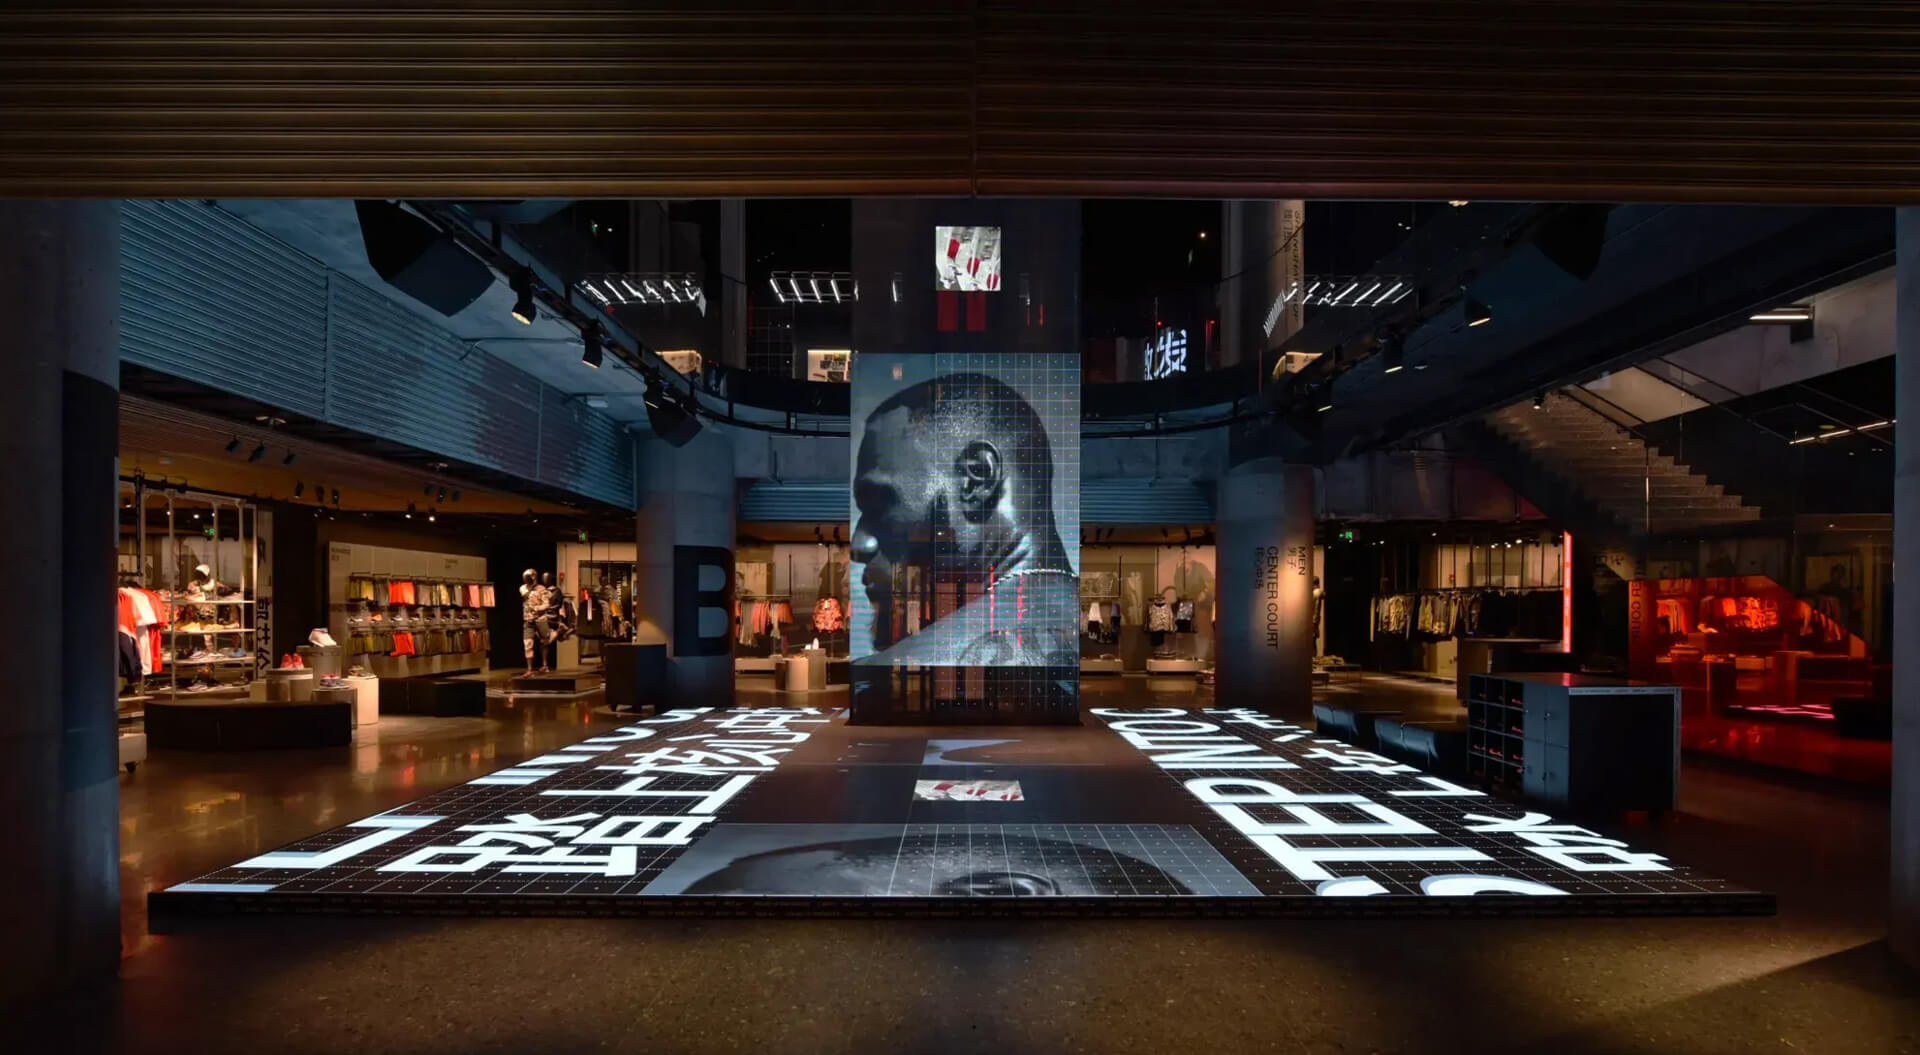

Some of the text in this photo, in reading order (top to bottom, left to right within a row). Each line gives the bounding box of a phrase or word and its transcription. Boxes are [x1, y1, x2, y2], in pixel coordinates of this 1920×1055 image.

[1266, 546, 1279, 649] CENTER COURT
[1297, 546, 1305, 576] MEN
[673, 545, 735, 657] B
[1108, 719, 1302, 770] INTO
